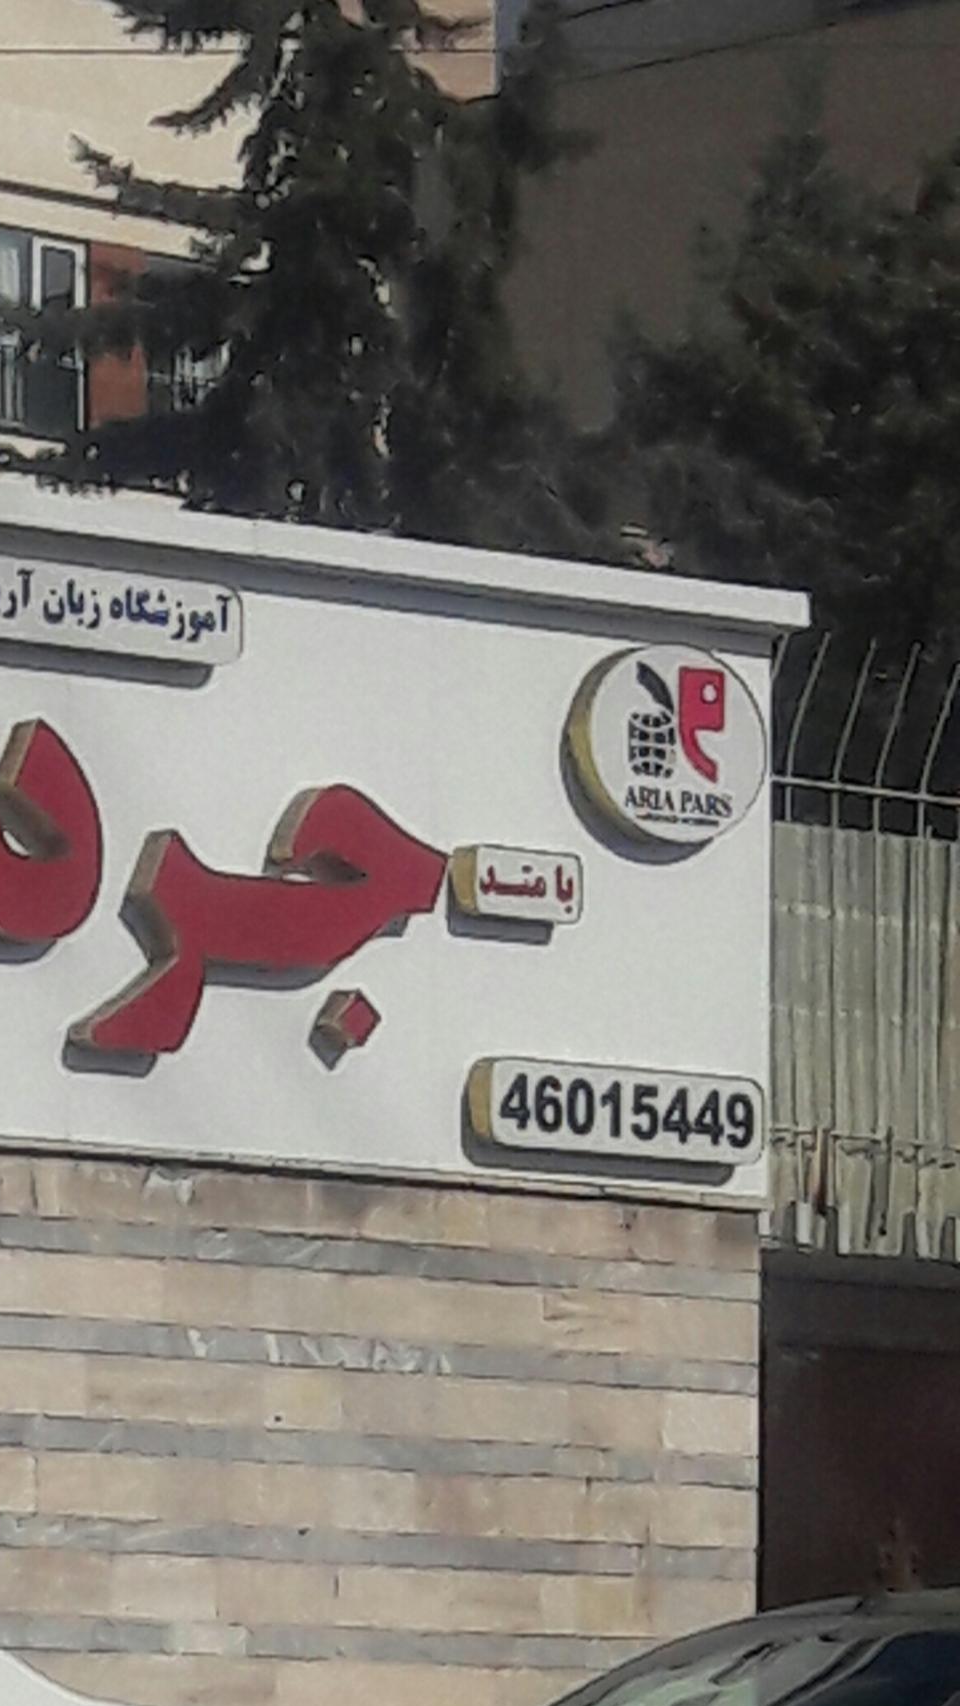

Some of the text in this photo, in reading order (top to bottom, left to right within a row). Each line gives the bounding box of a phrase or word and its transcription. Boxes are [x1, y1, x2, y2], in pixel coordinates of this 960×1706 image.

[42, 580, 100, 629] زبان
[109, 585, 232, 642] آموزشگاه
[625, 785, 734, 819] ARIA PARS
[480, 864, 573, 914] با متد
[499, 1072, 755, 1149] 46015449
